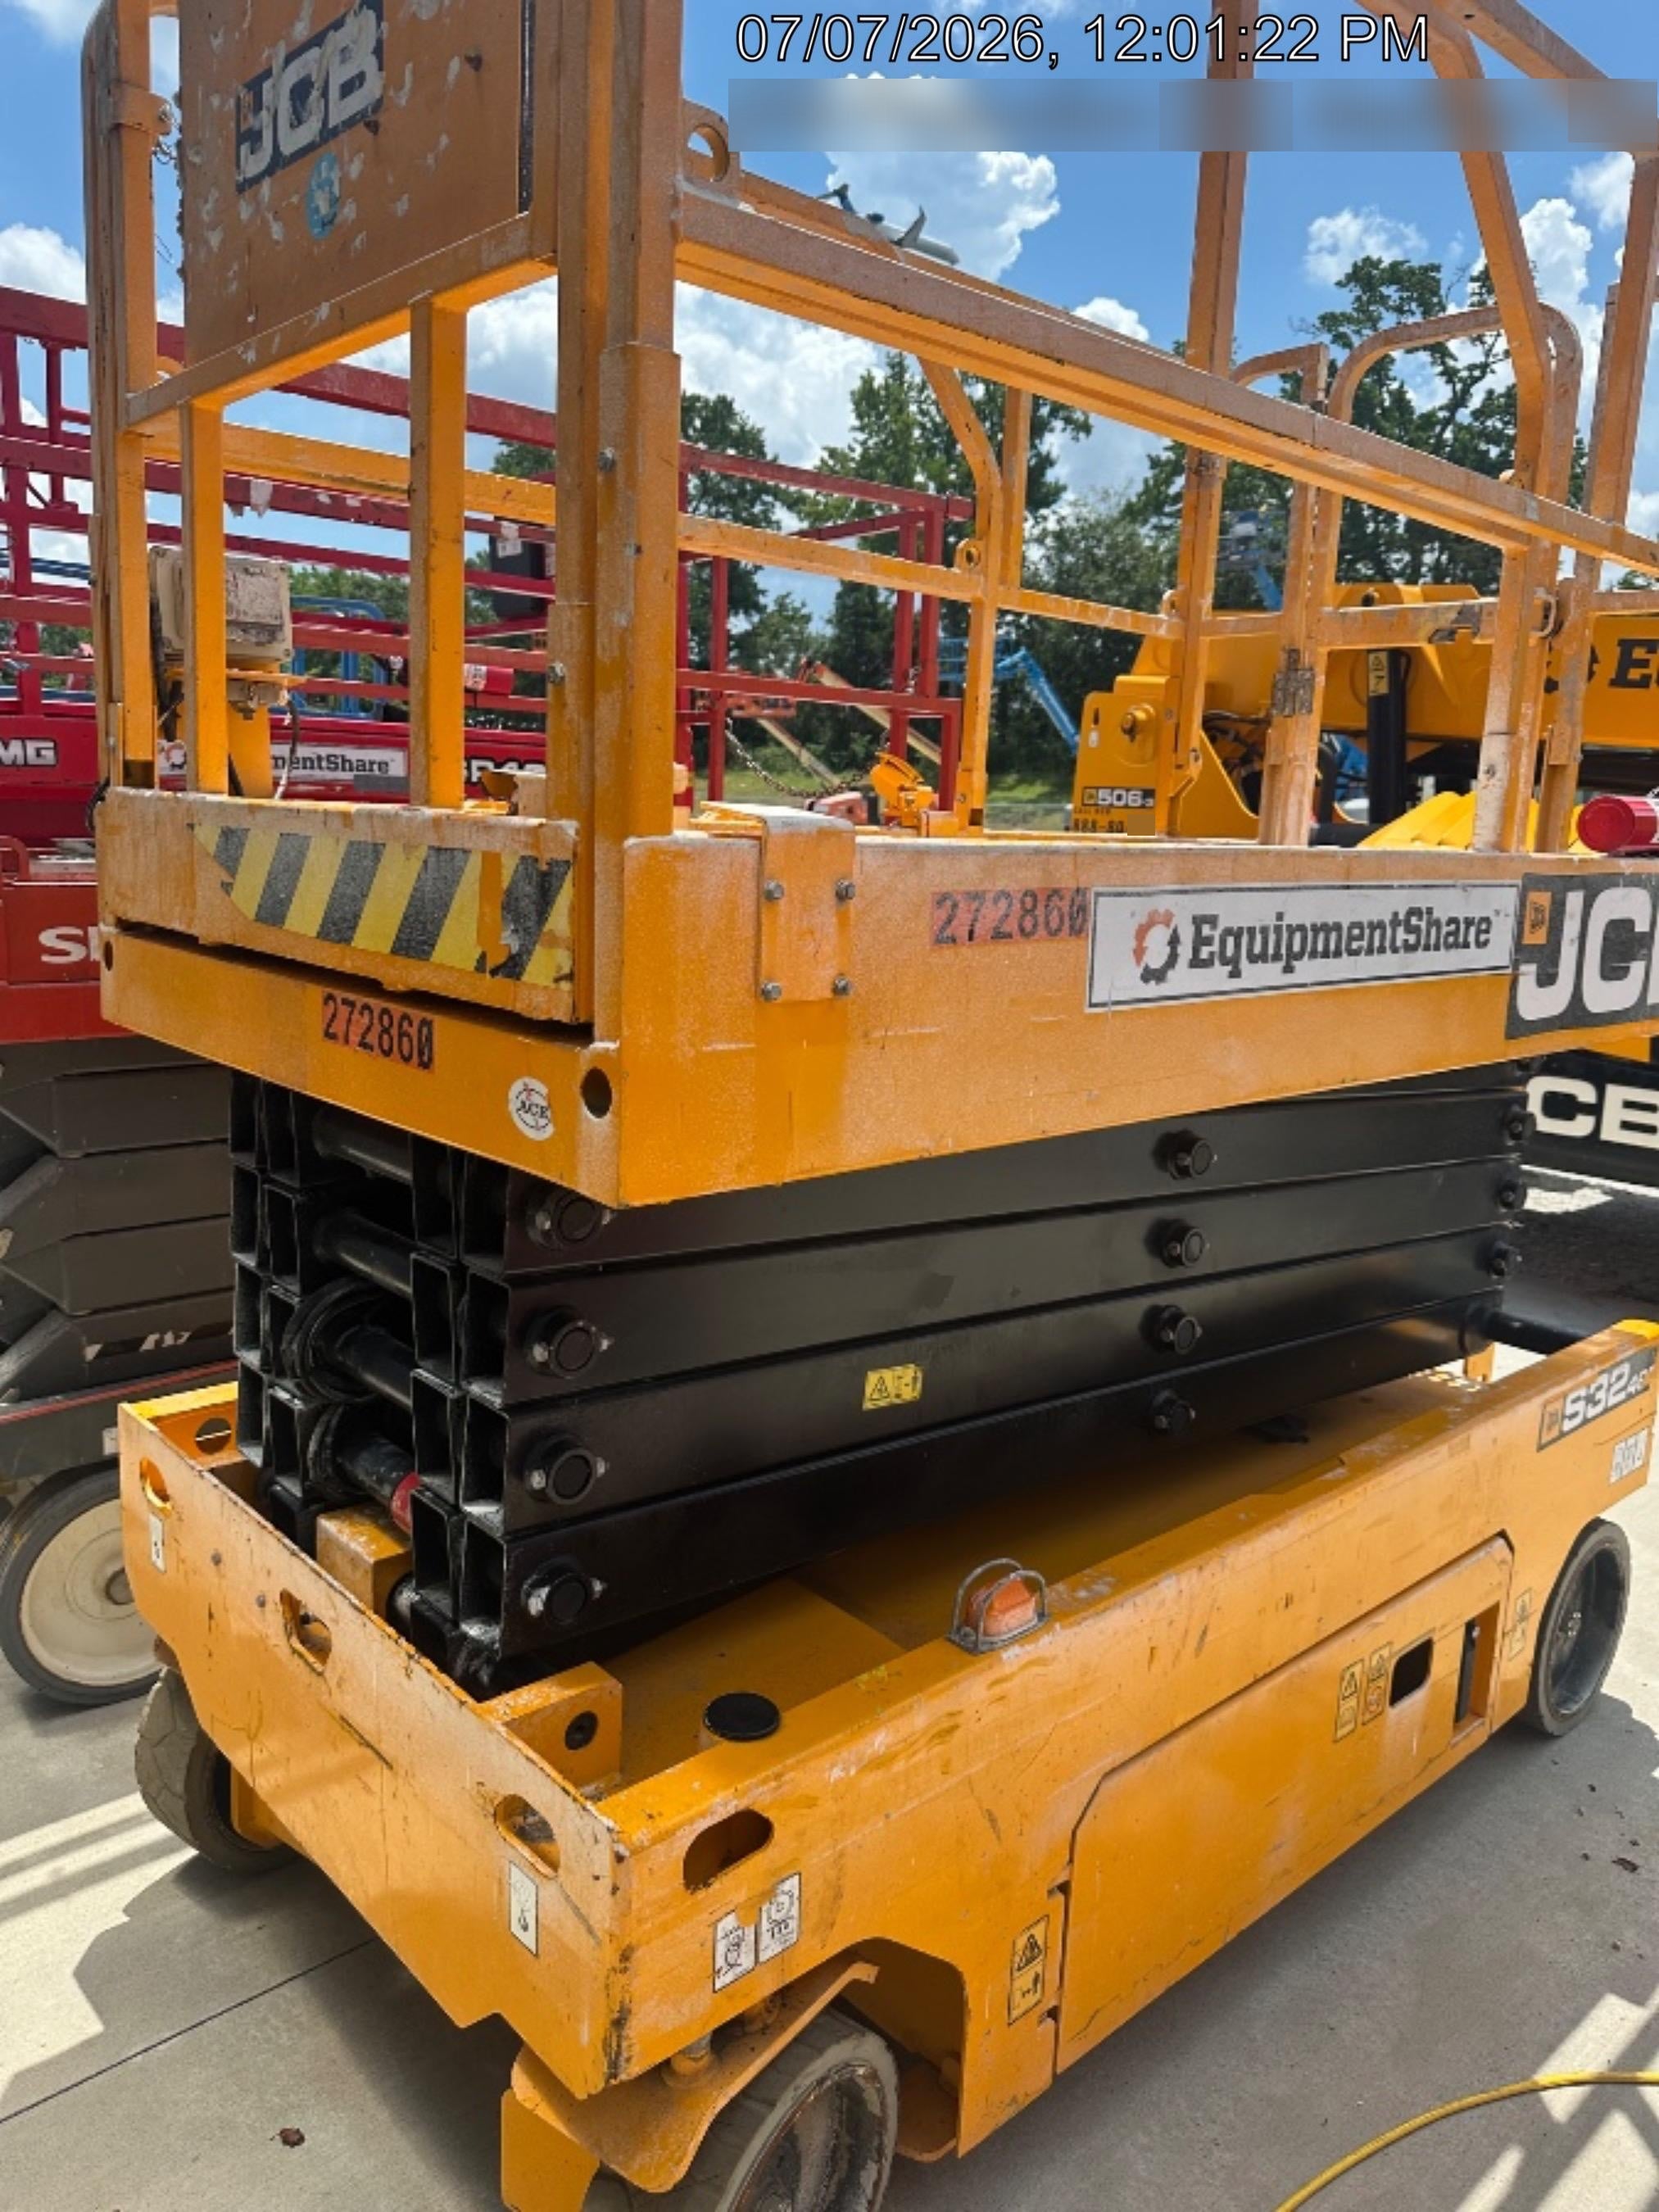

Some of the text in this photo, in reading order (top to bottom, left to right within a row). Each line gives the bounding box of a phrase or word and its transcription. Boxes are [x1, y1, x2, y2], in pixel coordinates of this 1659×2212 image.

[239, 7, 383, 181] JCB
[1608, 638, 1659, 689] E
[934, 887, 1088, 945] 272860
[1188, 906, 1493, 979] EquipmentShare
[1516, 886, 1659, 1022] JC
[323, 992, 434, 1070] 272860
